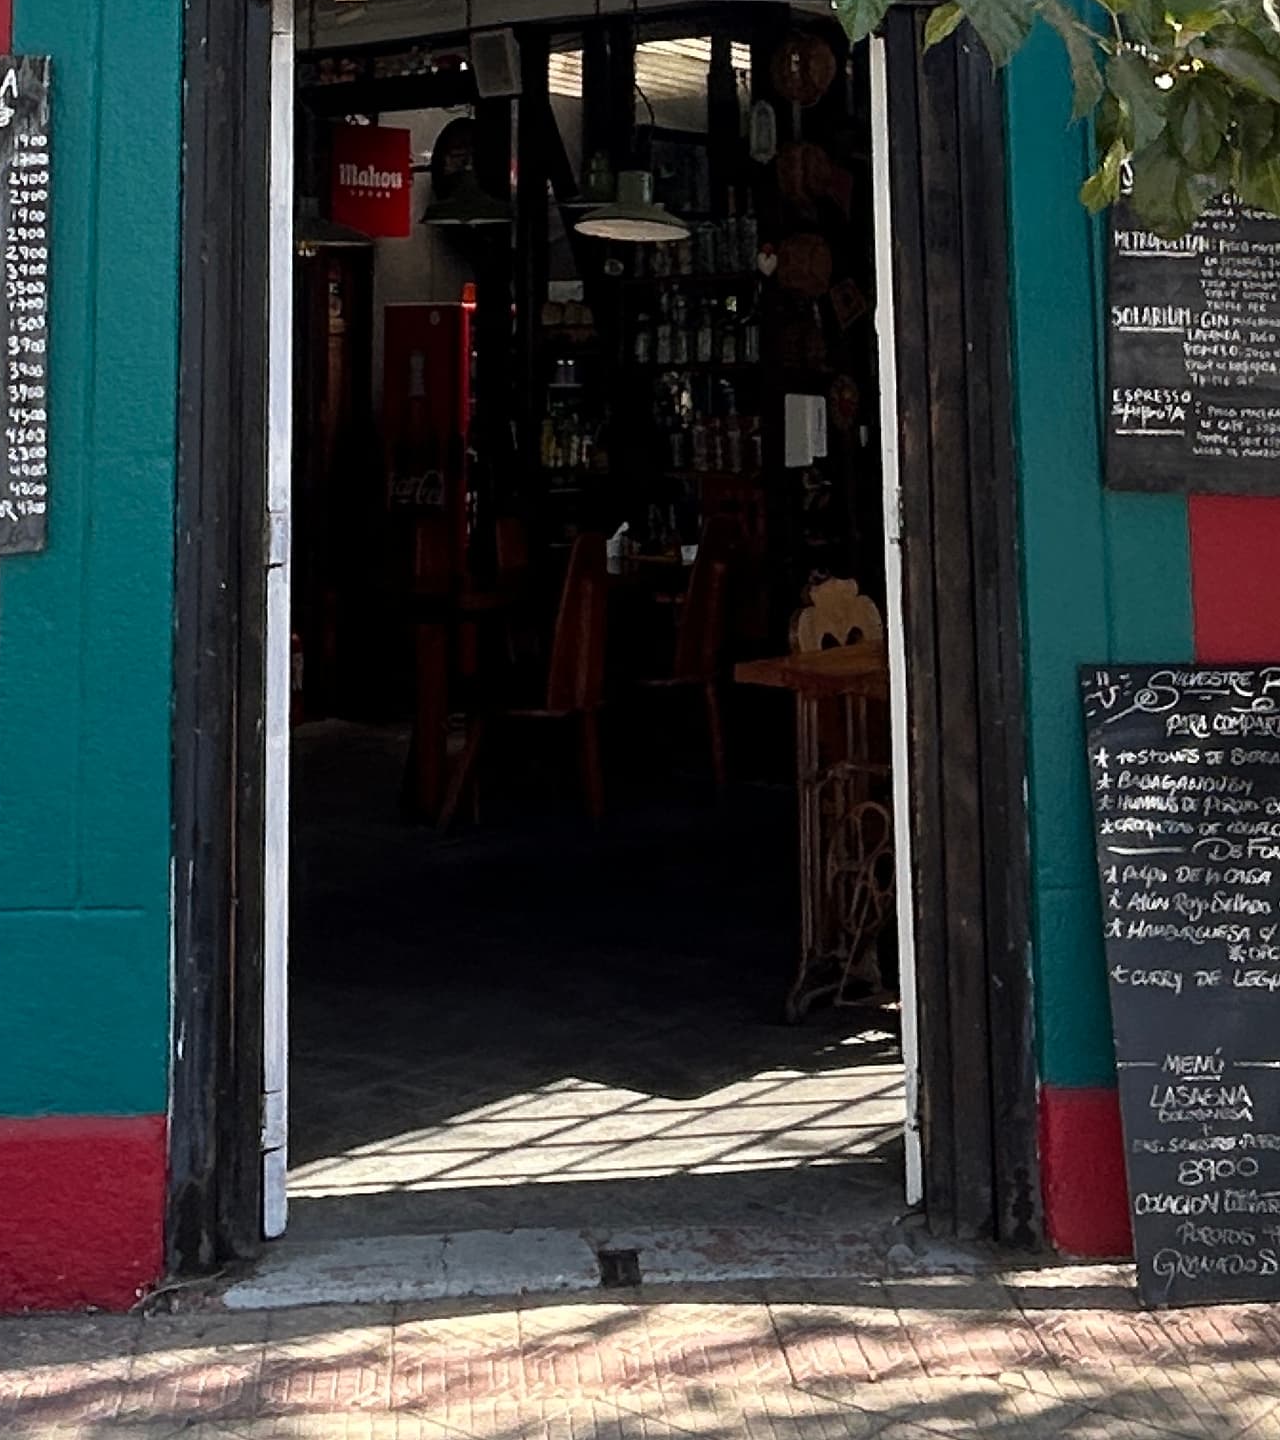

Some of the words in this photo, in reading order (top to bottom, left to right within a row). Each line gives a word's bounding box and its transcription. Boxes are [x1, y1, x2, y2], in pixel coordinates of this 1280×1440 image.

[339, 163, 403, 188] Mahou
[1112, 388, 1192, 404] ESPRESSO
[1166, 714, 1212, 739] PARA
[1161, 1048, 1226, 1076] MENÚ
[1177, 1156, 1260, 1186] 8900
